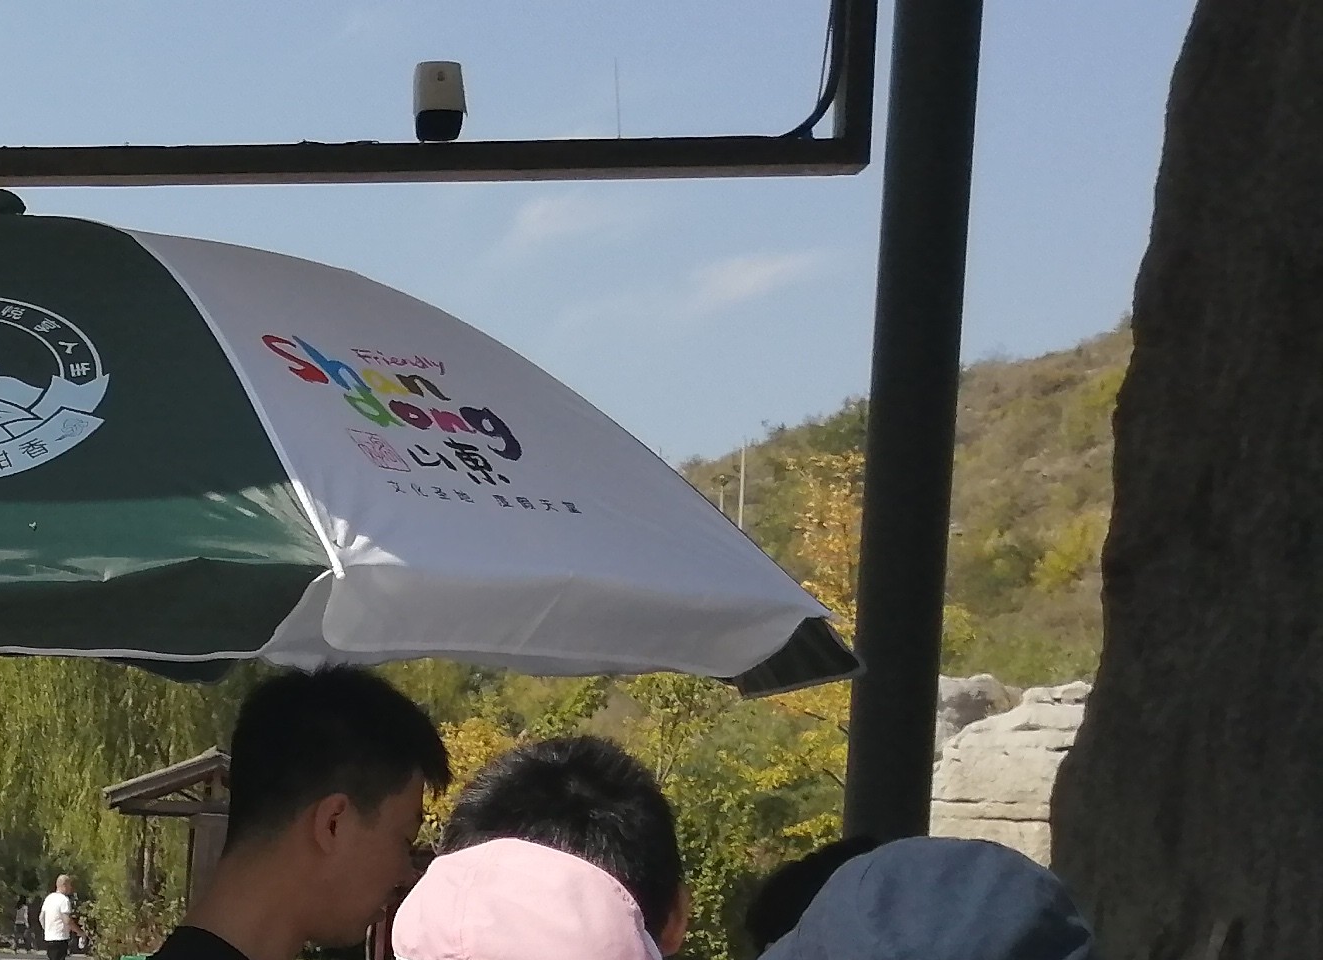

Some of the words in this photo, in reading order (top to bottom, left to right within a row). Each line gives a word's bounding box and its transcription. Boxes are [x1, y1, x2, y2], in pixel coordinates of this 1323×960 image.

[261, 334, 452, 401] Shan
[350, 348, 446, 375] Friendly
[343, 384, 523, 461] dong
